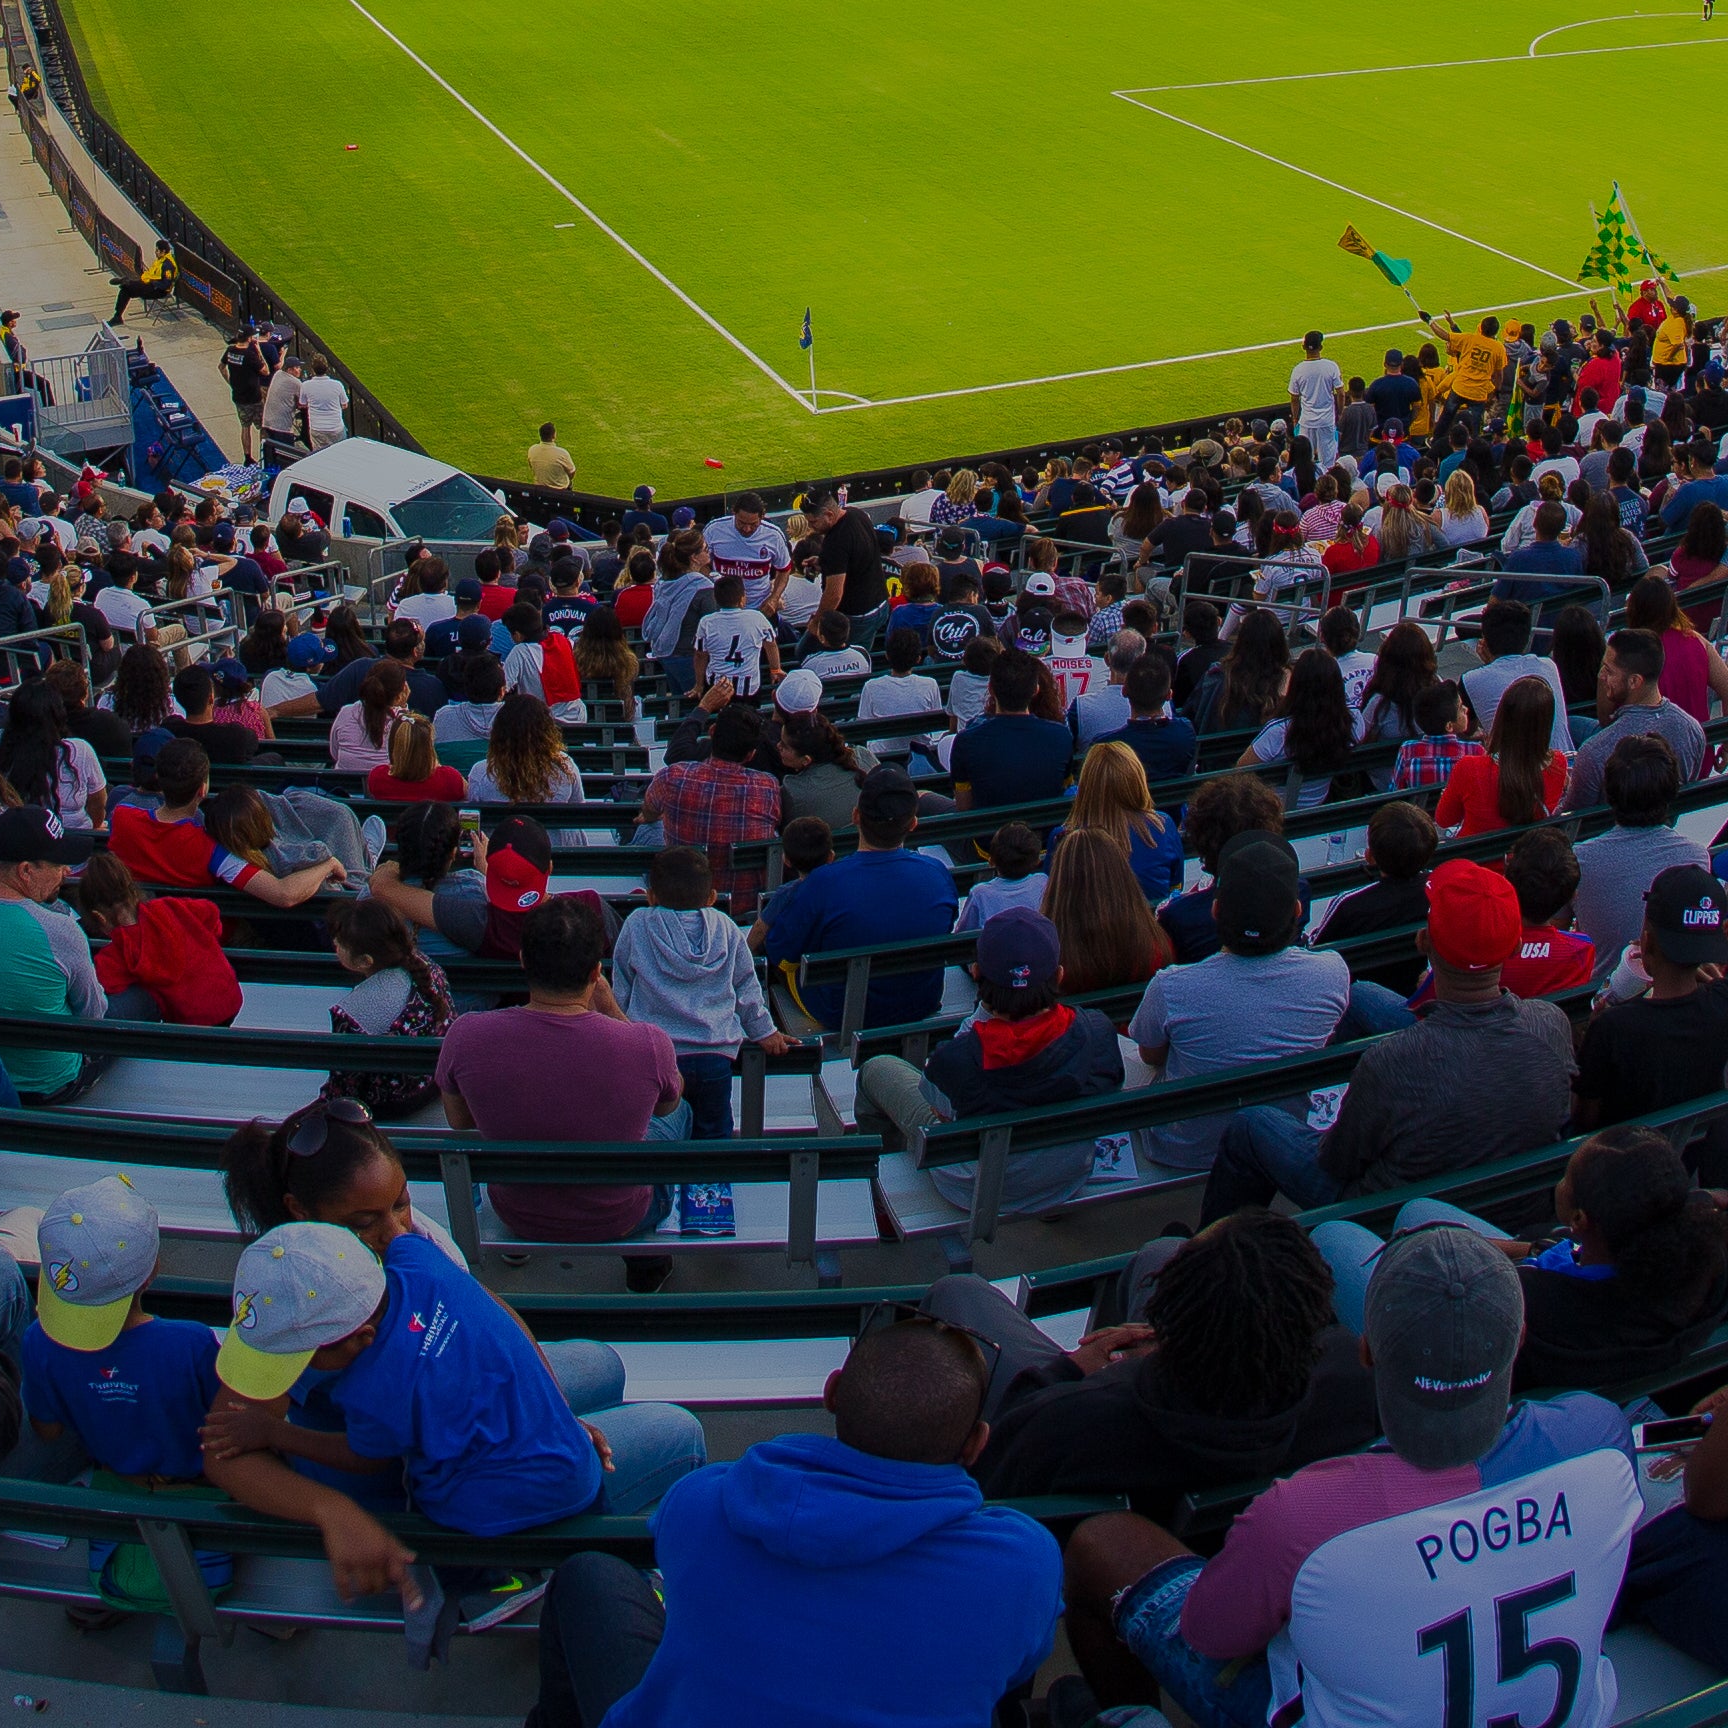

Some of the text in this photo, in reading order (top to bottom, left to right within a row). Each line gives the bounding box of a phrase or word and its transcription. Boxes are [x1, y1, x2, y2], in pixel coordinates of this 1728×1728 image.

[1471, 347, 1491, 362] 20
[407, 478, 435, 493] NISSAN
[720, 567, 765, 580] Emirates
[549, 608, 586, 622] DONOVAN
[725, 635, 744, 667] 4
[827, 661, 860, 673] JULIAN
[1052, 658, 1092, 669] MOISES
[1052, 673, 1093, 710] 17
[1683, 909, 1720, 925] CLIPPERS
[1521, 942, 1550, 959] USA
[1415, 1371, 1491, 1390] NEVERMIND
[1415, 1491, 1574, 1581] POGBA
[1416, 1569, 1582, 1728] 15
